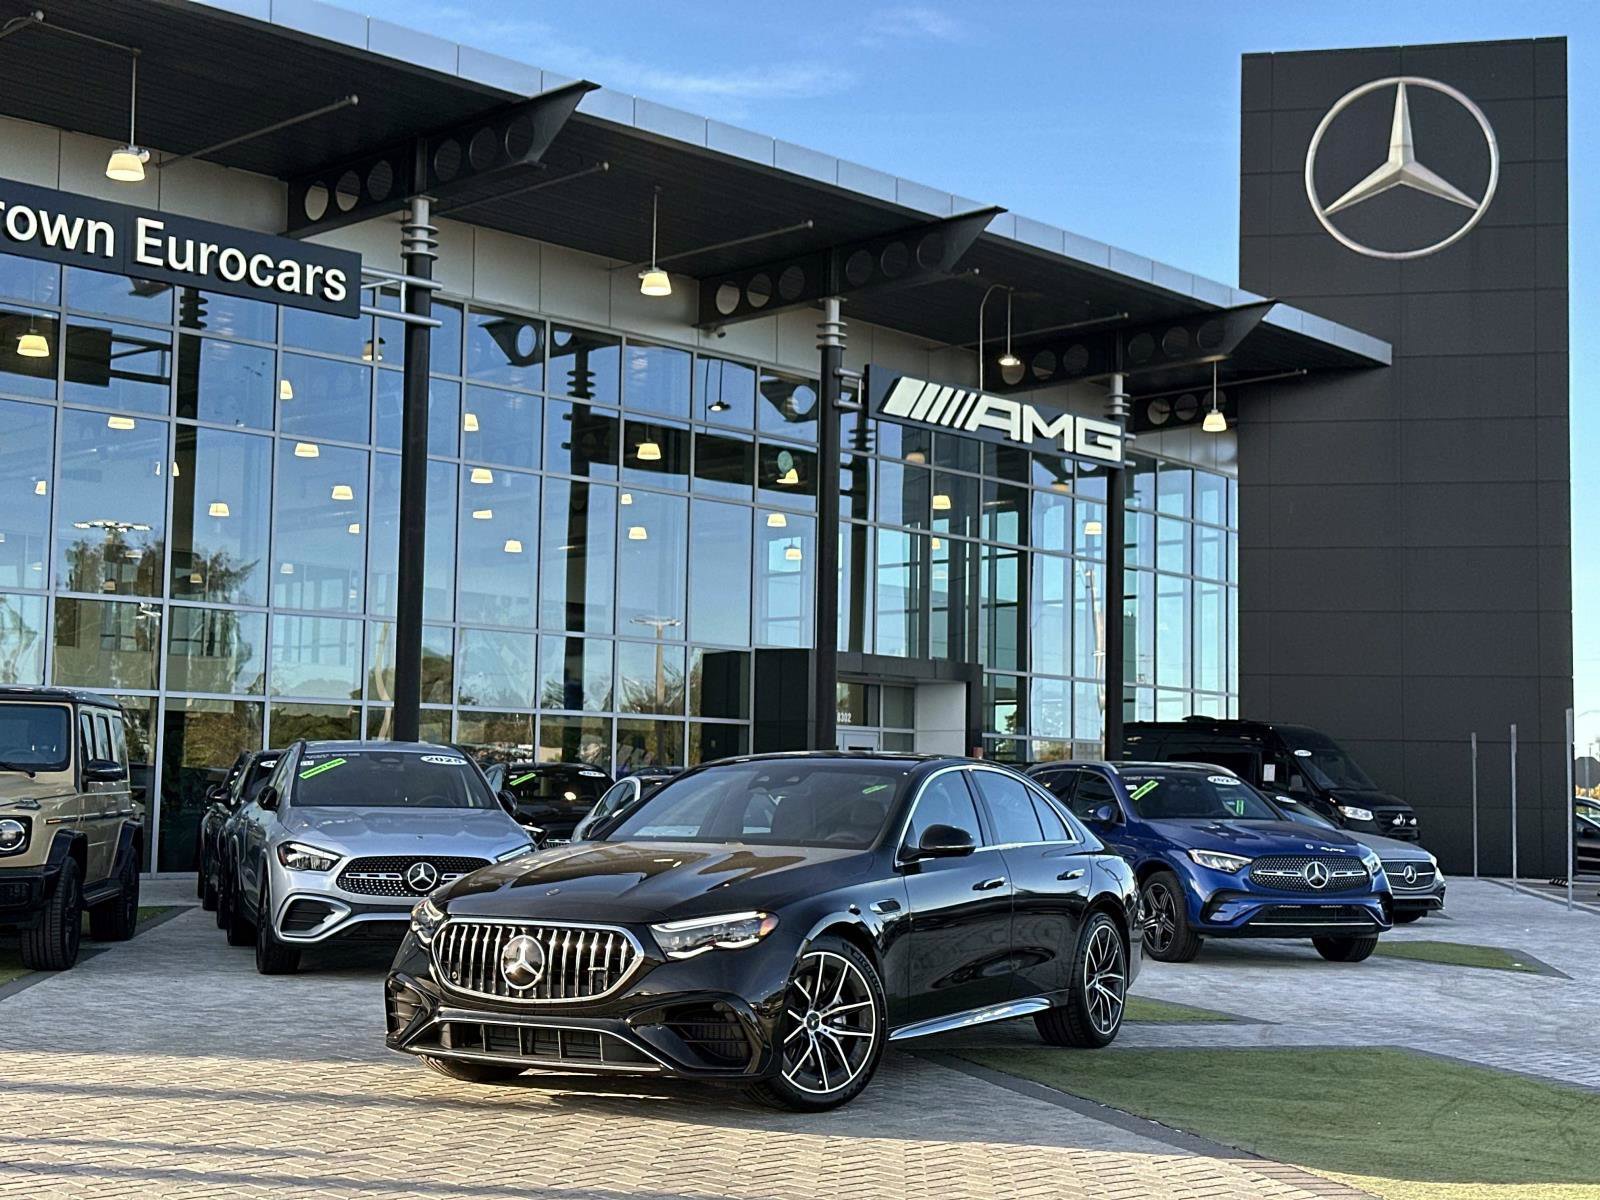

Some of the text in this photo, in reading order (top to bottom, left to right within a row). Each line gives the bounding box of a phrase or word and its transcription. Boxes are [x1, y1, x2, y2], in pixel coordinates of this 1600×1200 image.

[0, 201, 347, 301] own Eurocars
[964, 395, 1122, 462] AMG
